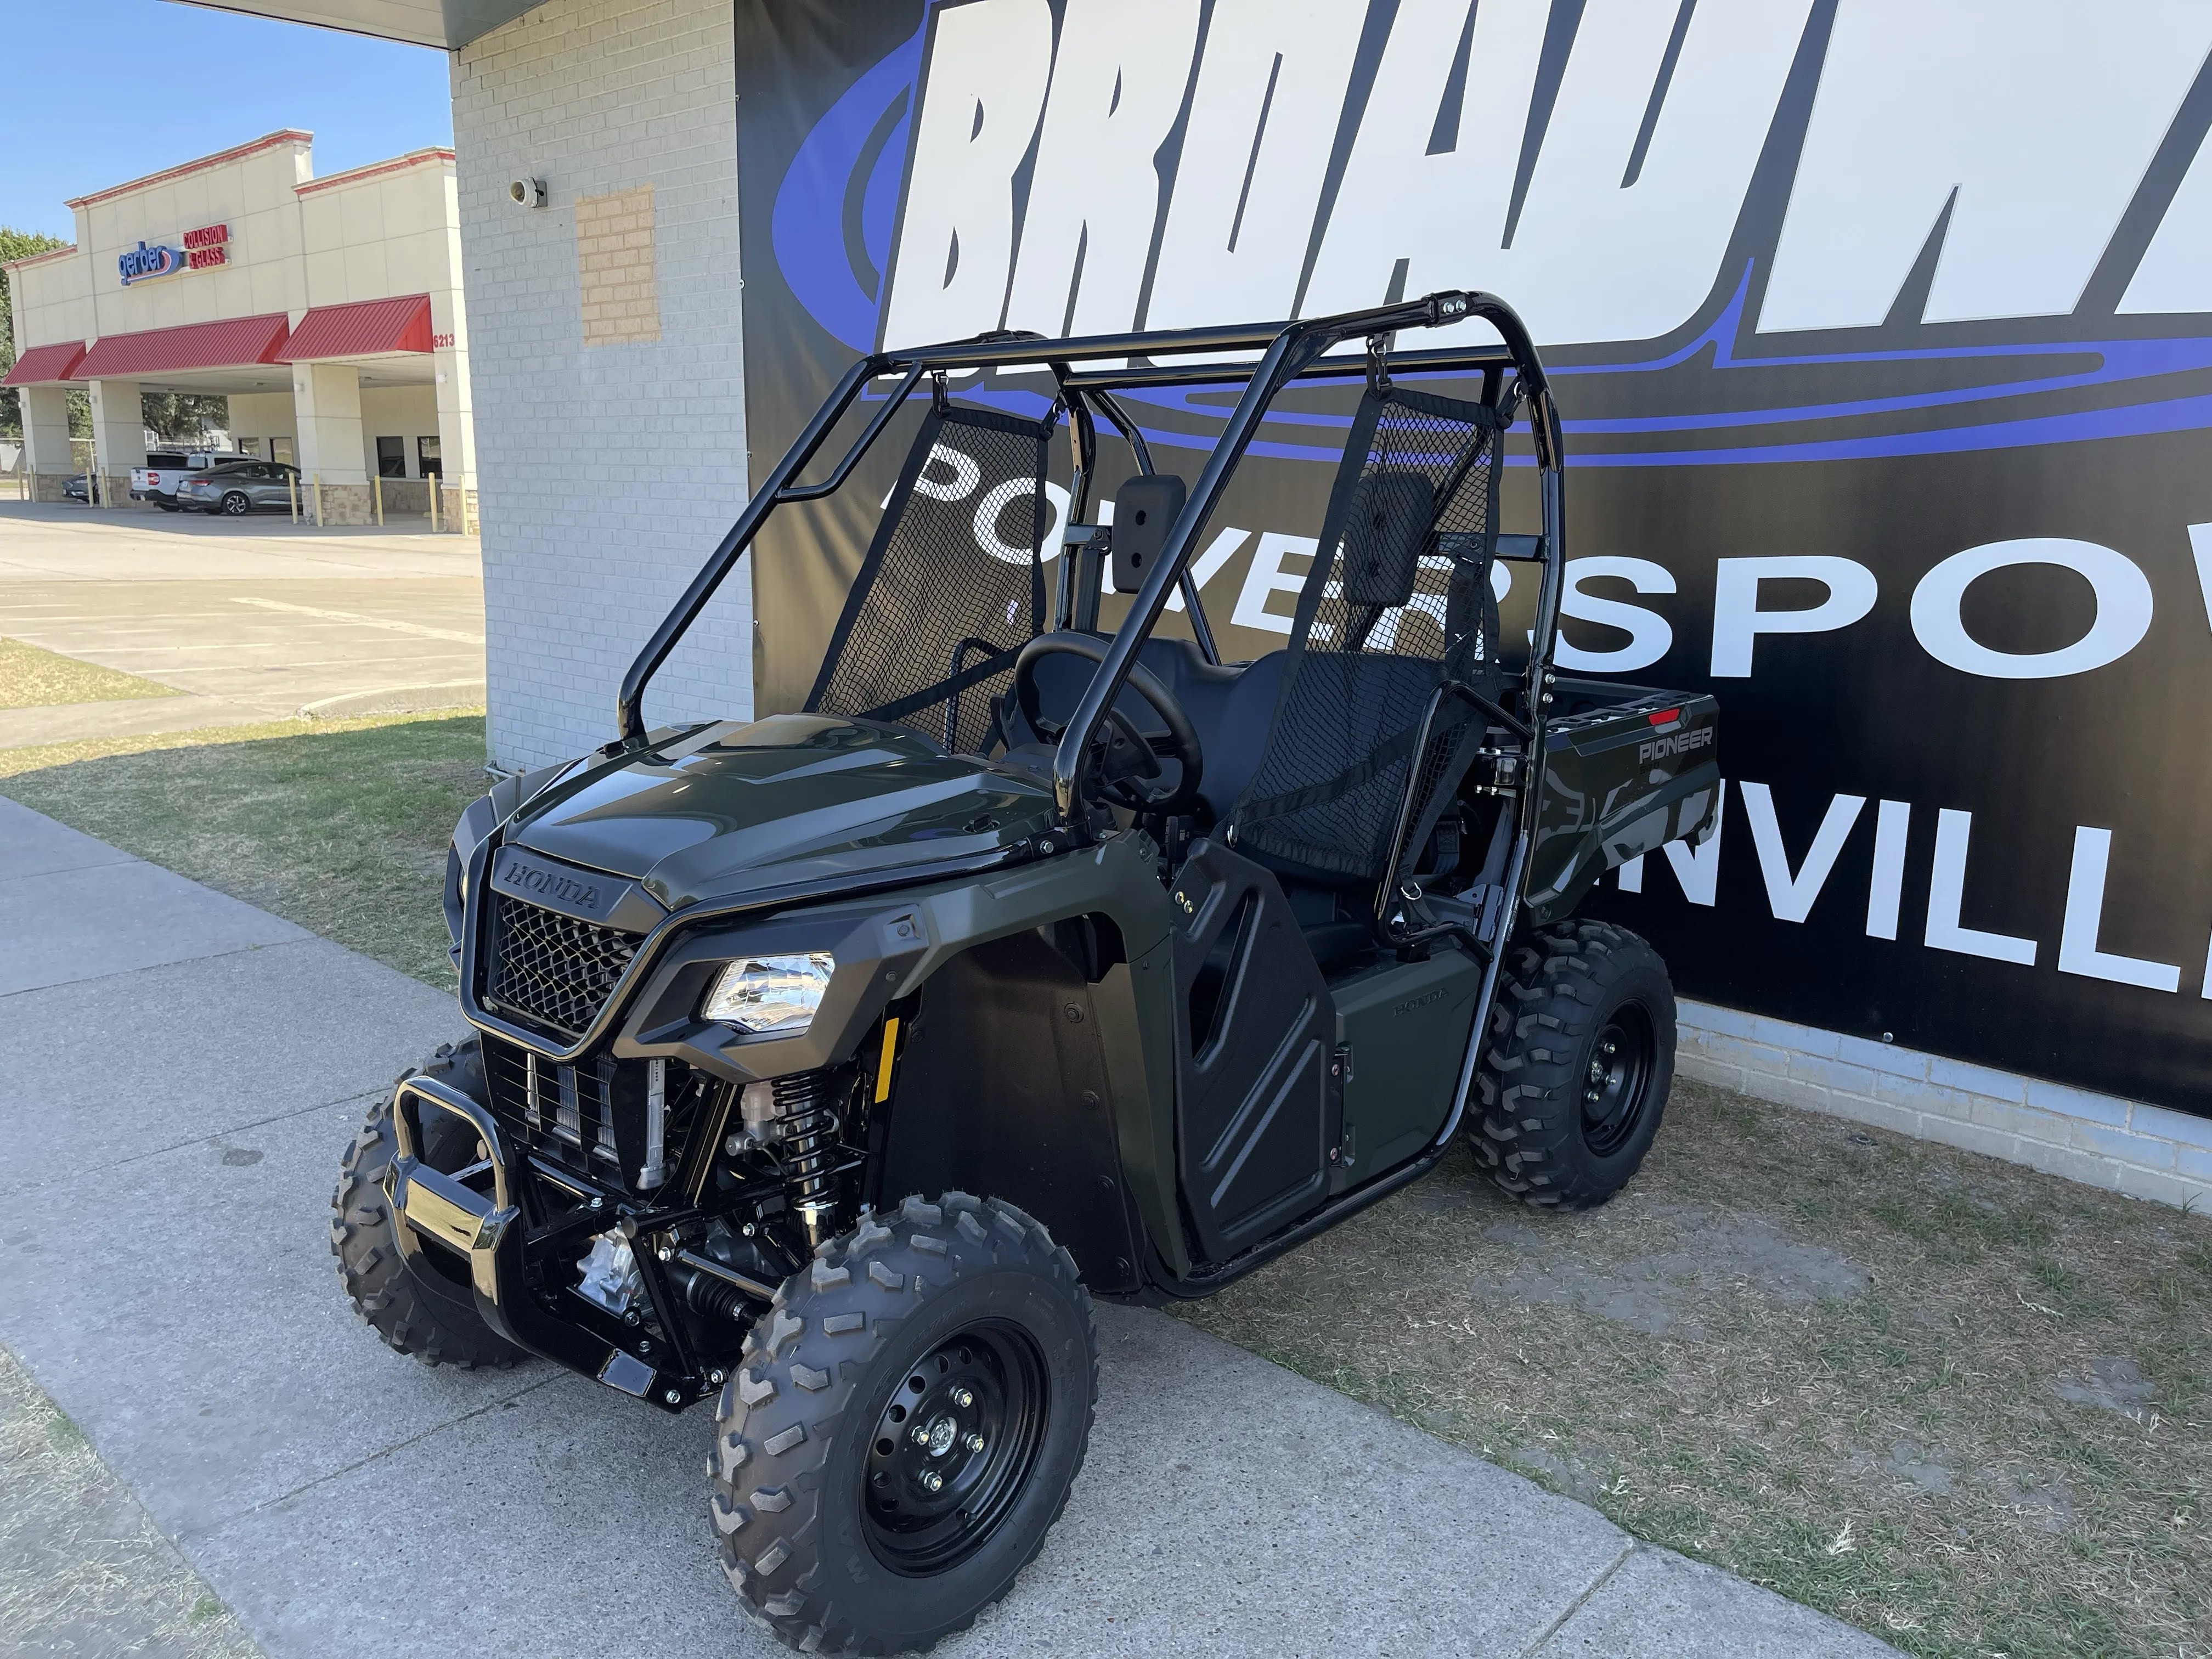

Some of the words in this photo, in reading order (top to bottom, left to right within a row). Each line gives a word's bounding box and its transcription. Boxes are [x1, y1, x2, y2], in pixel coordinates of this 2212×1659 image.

[183, 225, 227, 249] COLLISION
[119, 241, 167, 286] gerber
[189, 252, 199, 269] &
[195, 247, 224, 268] GLASS
[433, 333, 455, 348] 6213
[1639, 726, 1713, 764] PIONEER
[504, 862, 602, 909] HONDA
[1392, 987, 1449, 1018] HONDA
